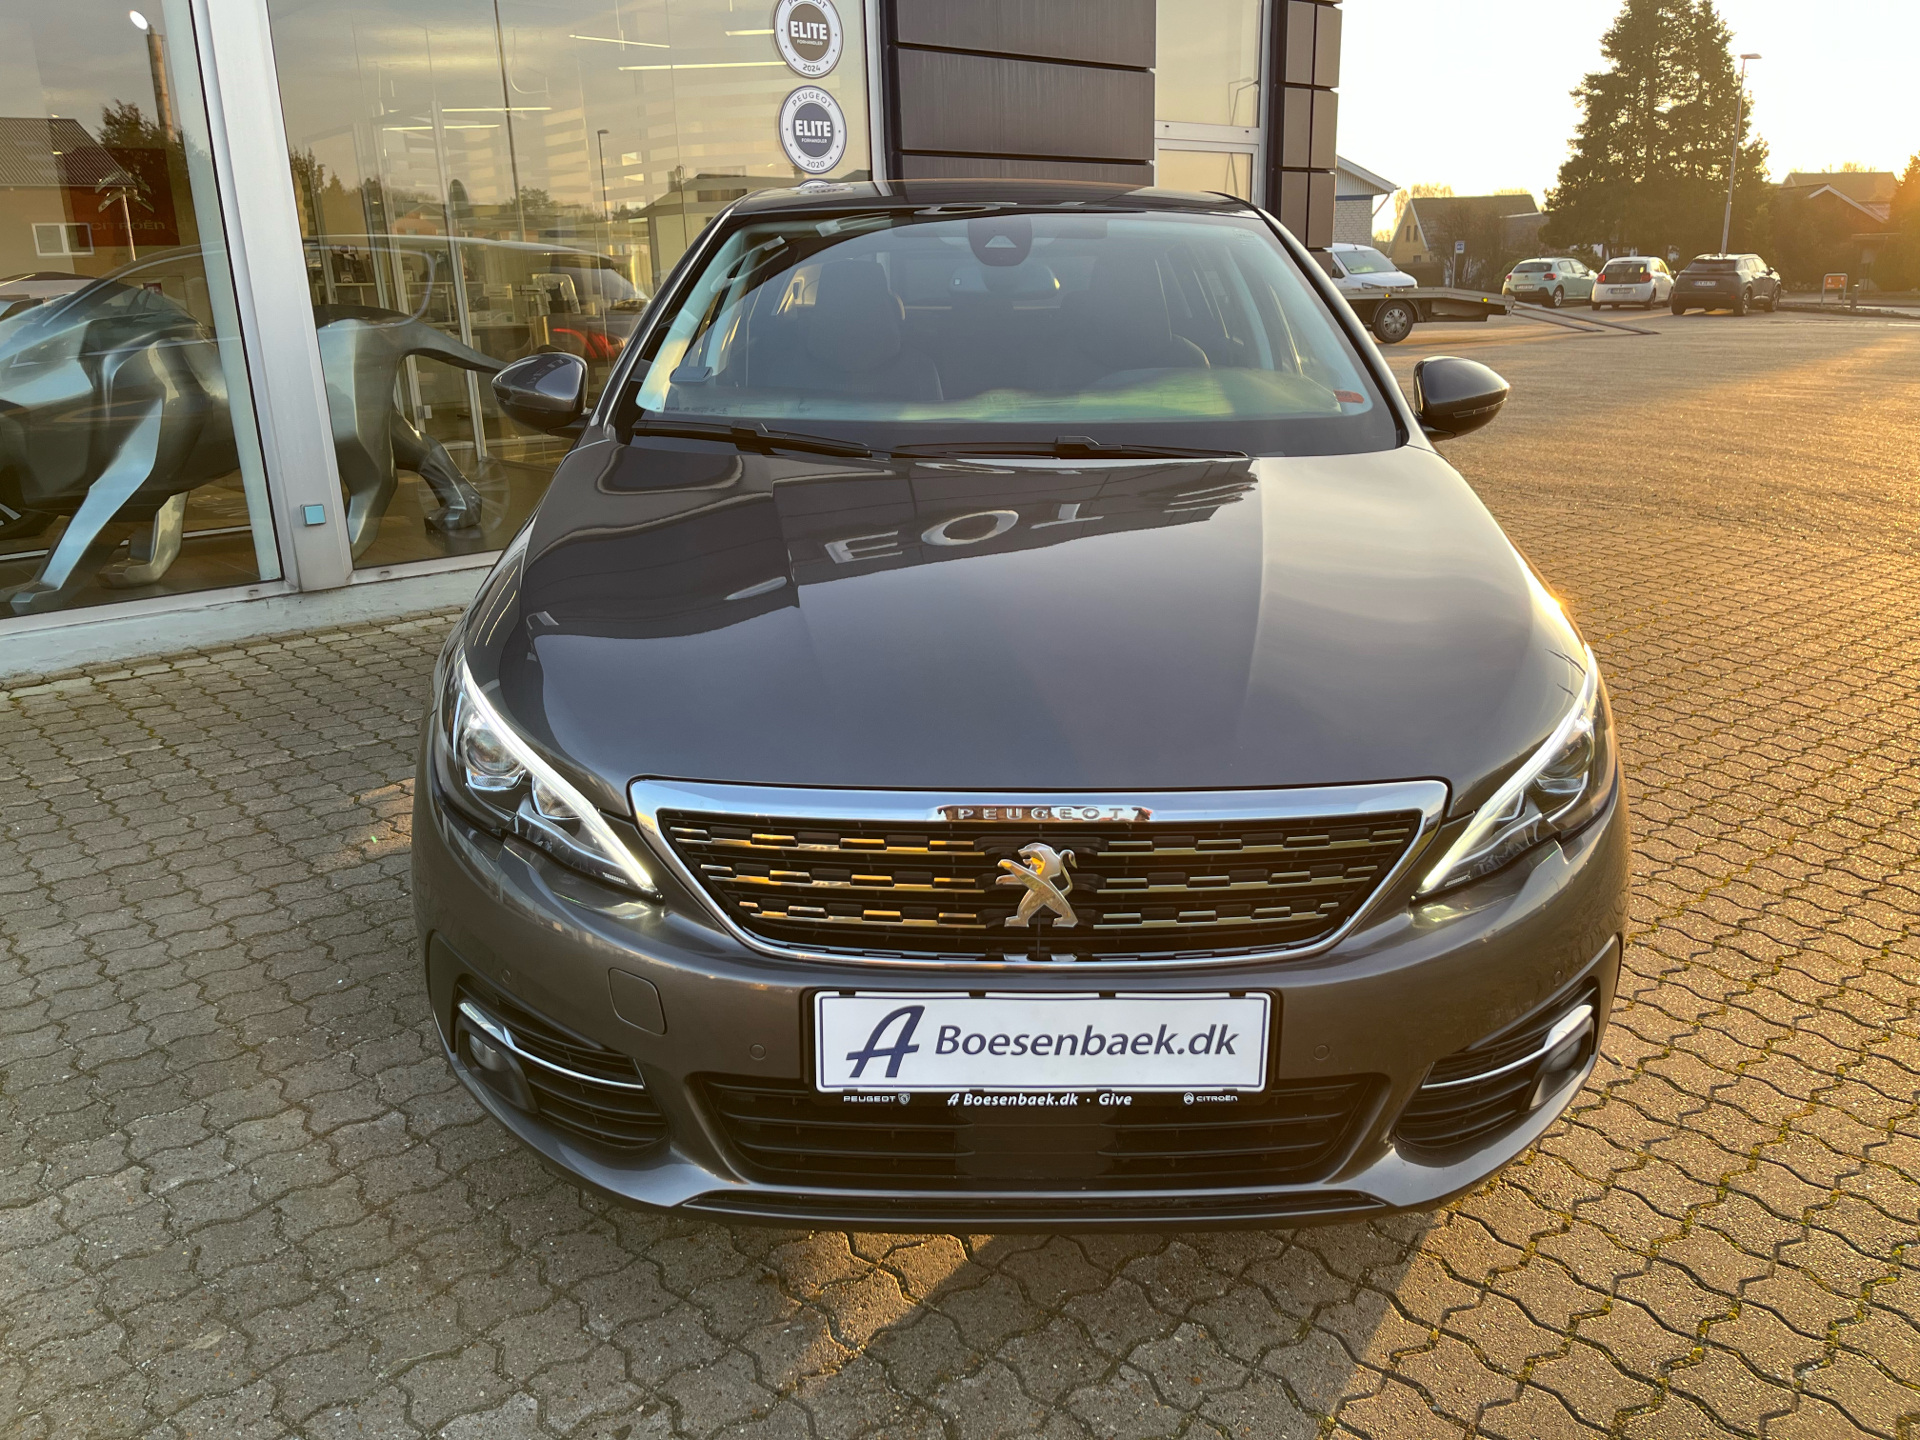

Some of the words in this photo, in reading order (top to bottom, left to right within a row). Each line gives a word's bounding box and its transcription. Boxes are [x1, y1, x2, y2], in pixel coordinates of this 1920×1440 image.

[790, 20, 828, 40] ELITE
[802, 63, 821, 72] 2024
[791, 91, 832, 108] PEUGEOT
[794, 119, 831, 137] ELITE
[806, 160, 825, 169] 2020
[957, 806, 1124, 821] PEUGEOT
[845, 1004, 926, 1079] A
[934, 1023, 1240, 1057] Boesenbaek.dk
[843, 1095, 897, 1103] PEUGEOT
[963, 1092, 1079, 1106] Boesenbaek.dk
[1098, 1092, 1133, 1106] Give
